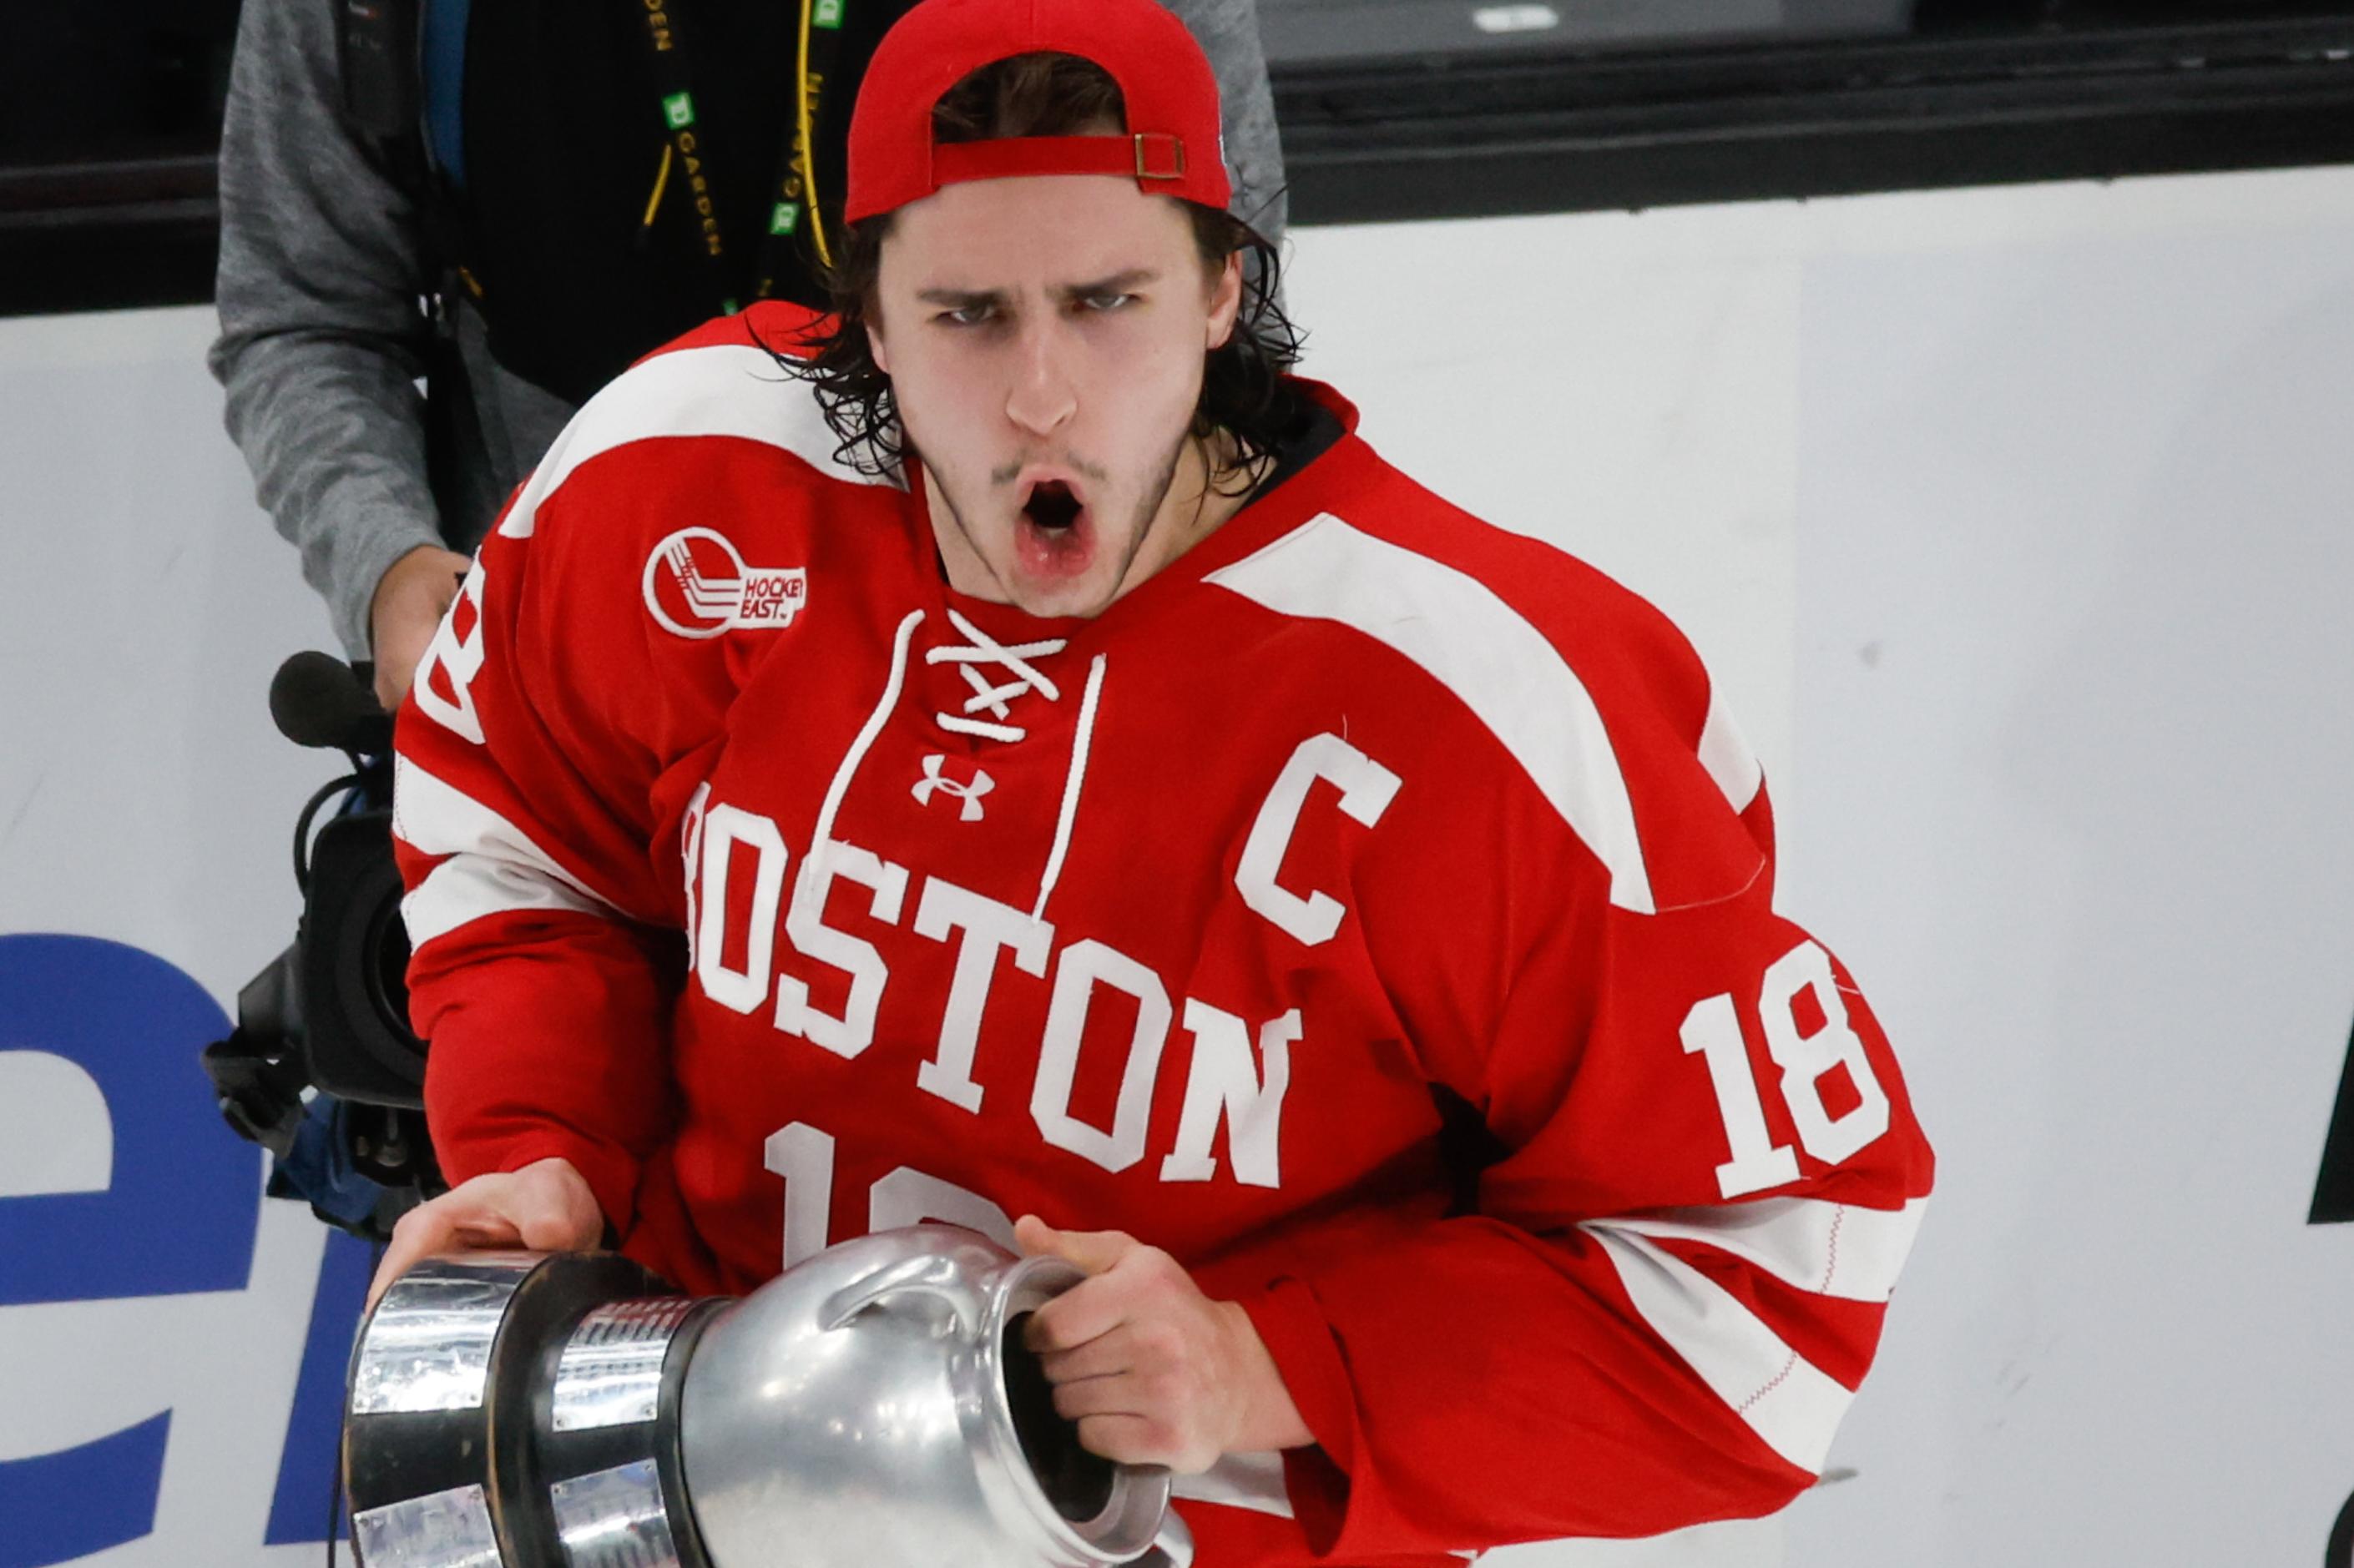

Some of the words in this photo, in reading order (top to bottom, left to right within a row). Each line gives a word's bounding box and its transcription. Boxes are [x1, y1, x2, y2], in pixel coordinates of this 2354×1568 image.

[745, 576, 804, 598] HOCKE
[1234, 731, 1404, 946] C
[1678, 939, 1891, 1200] 18
